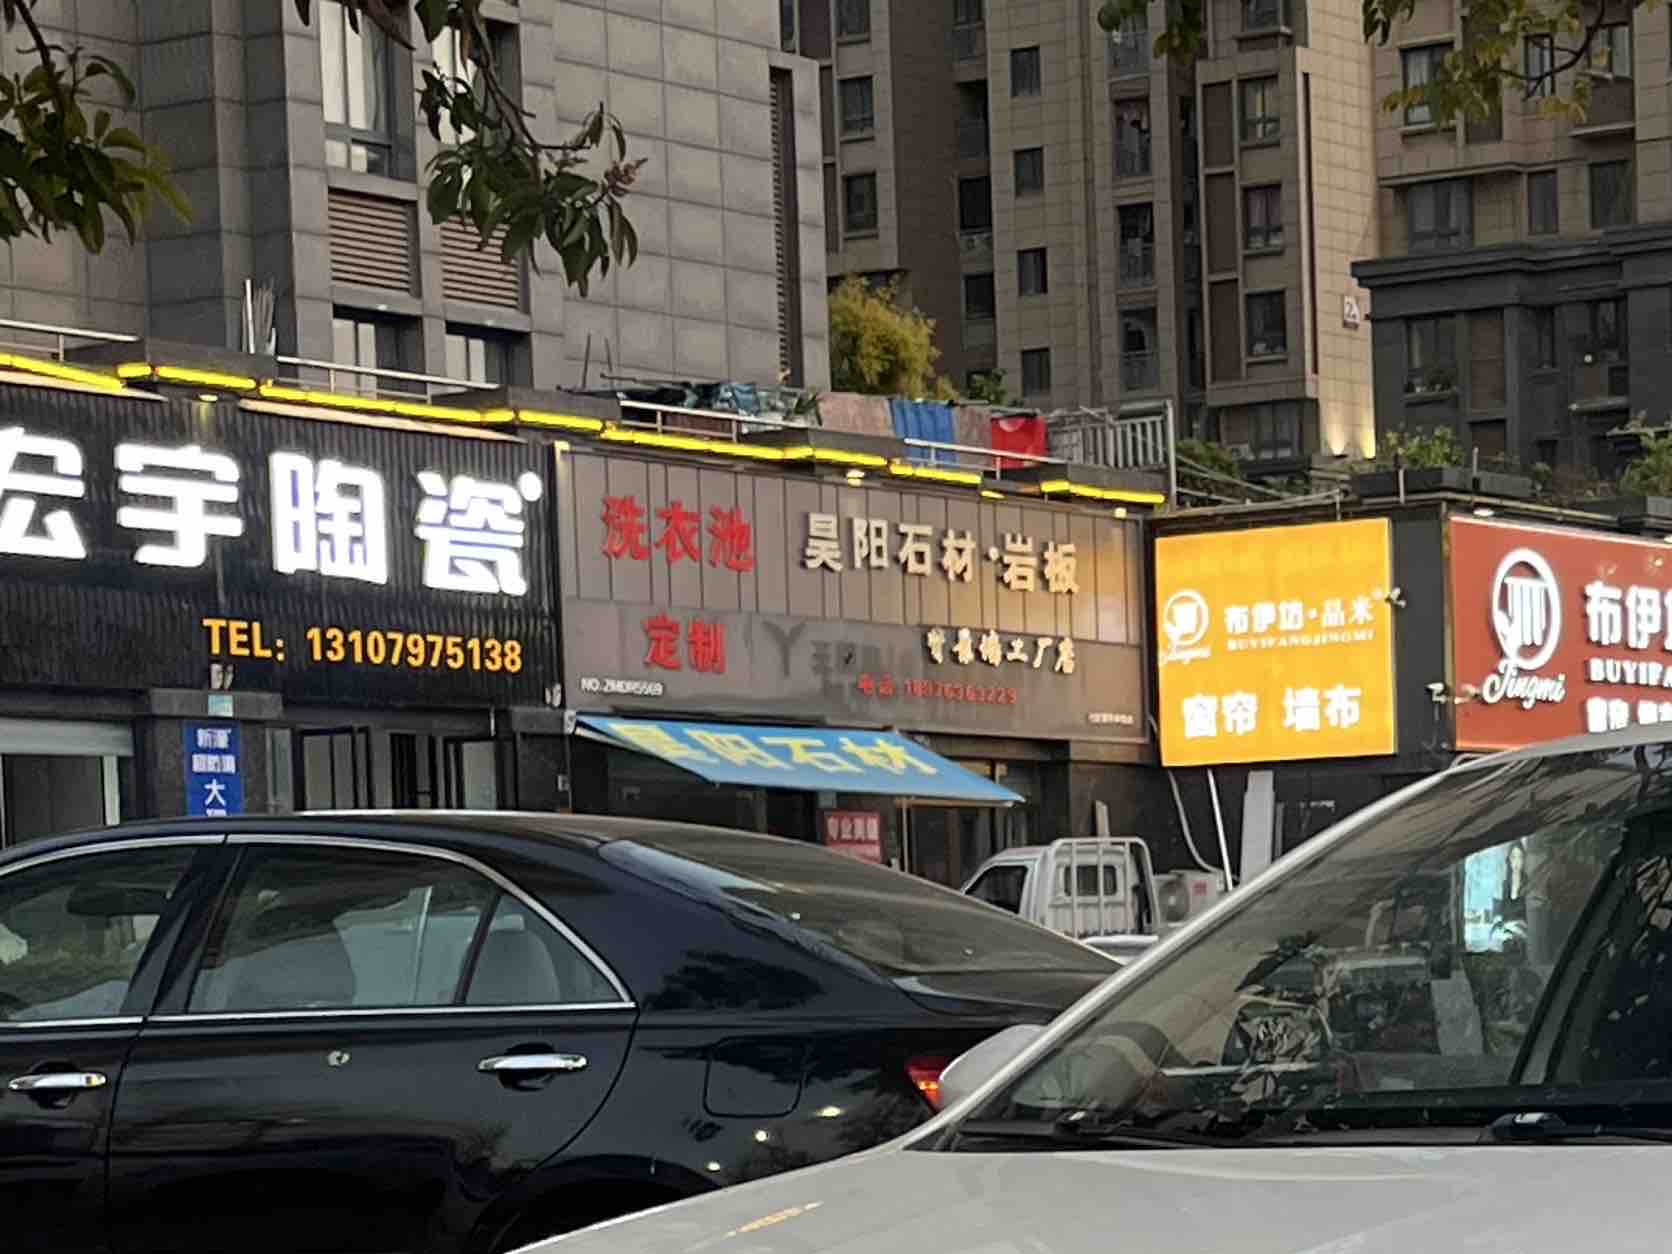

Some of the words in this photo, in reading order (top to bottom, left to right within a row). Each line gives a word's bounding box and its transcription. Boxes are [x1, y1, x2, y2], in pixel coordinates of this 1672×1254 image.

[0, 427, 528, 596] 宏宇陶瓷
[602, 496, 755, 572] 洗衣池
[203, 618, 285, 662] TEL:
[306, 626, 523, 673] 13107975138
[641, 611, 726, 674] 定制
[1182, 690, 1259, 739] 窗帘
[1283, 683, 1362, 732] 墙布
[1482, 658, 1567, 711] Jingmi
